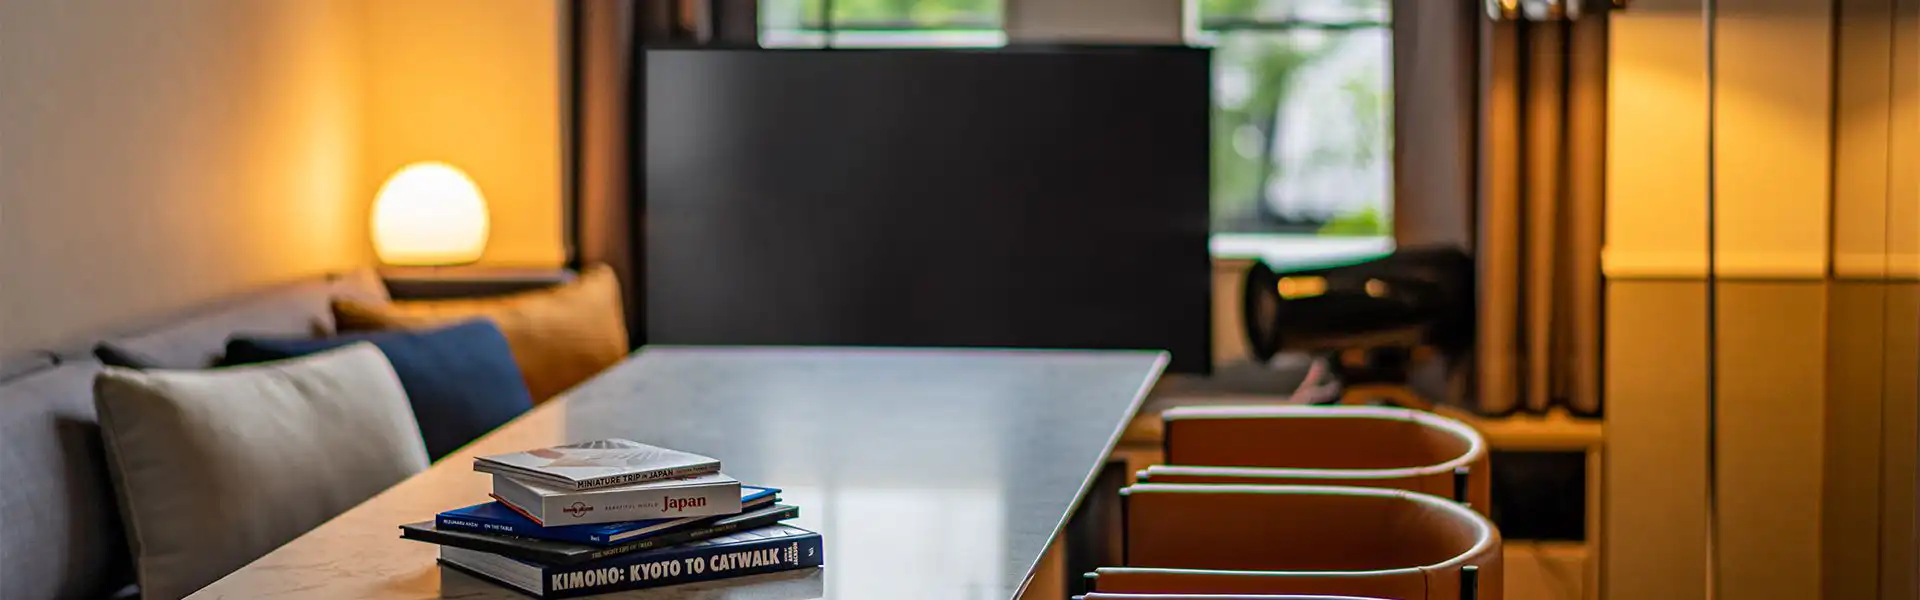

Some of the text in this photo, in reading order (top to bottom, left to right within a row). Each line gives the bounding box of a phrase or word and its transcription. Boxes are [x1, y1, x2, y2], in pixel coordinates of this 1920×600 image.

[577, 476, 621, 488] MINIATURE
[623, 473, 641, 482] TRIP
[649, 469, 674, 479] JAPAN
[605, 503, 636, 511] BEAUTIFUL
[661, 495, 707, 512] Japan
[552, 548, 780, 591] KIMONO: KYOTO TO CATWALK
